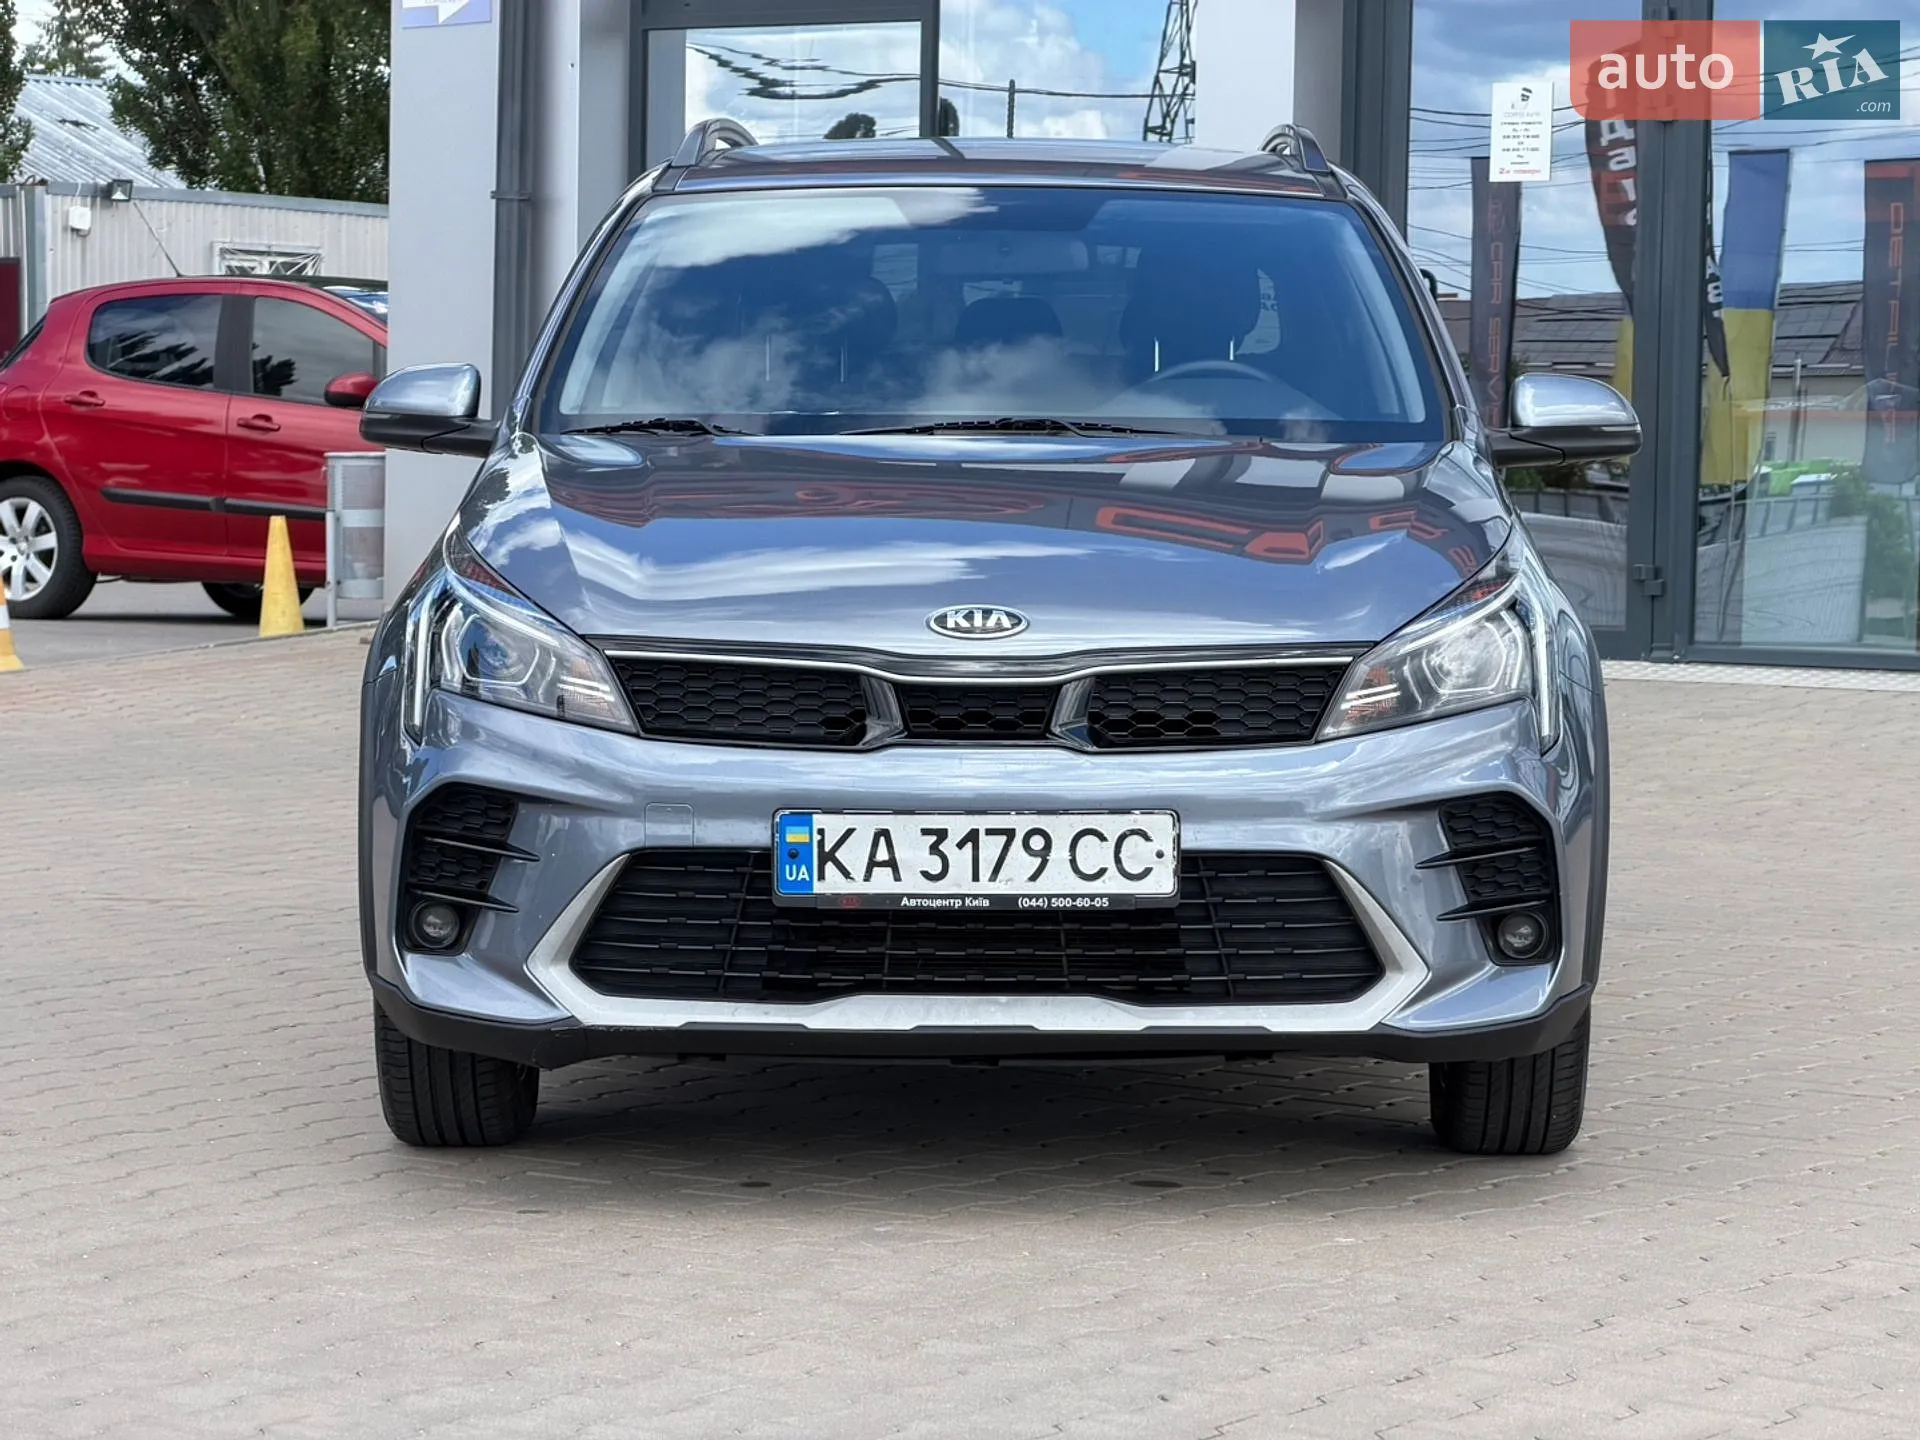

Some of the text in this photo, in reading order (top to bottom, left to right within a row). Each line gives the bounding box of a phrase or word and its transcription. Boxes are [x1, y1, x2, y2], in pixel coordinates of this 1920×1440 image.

[946, 609, 1012, 628] KIA
[817, 828, 1154, 882] KA 3179 CC
[785, 864, 810, 881] UA
[901, 896, 1109, 909] Автоцентр Київ (044) 500-60-05
